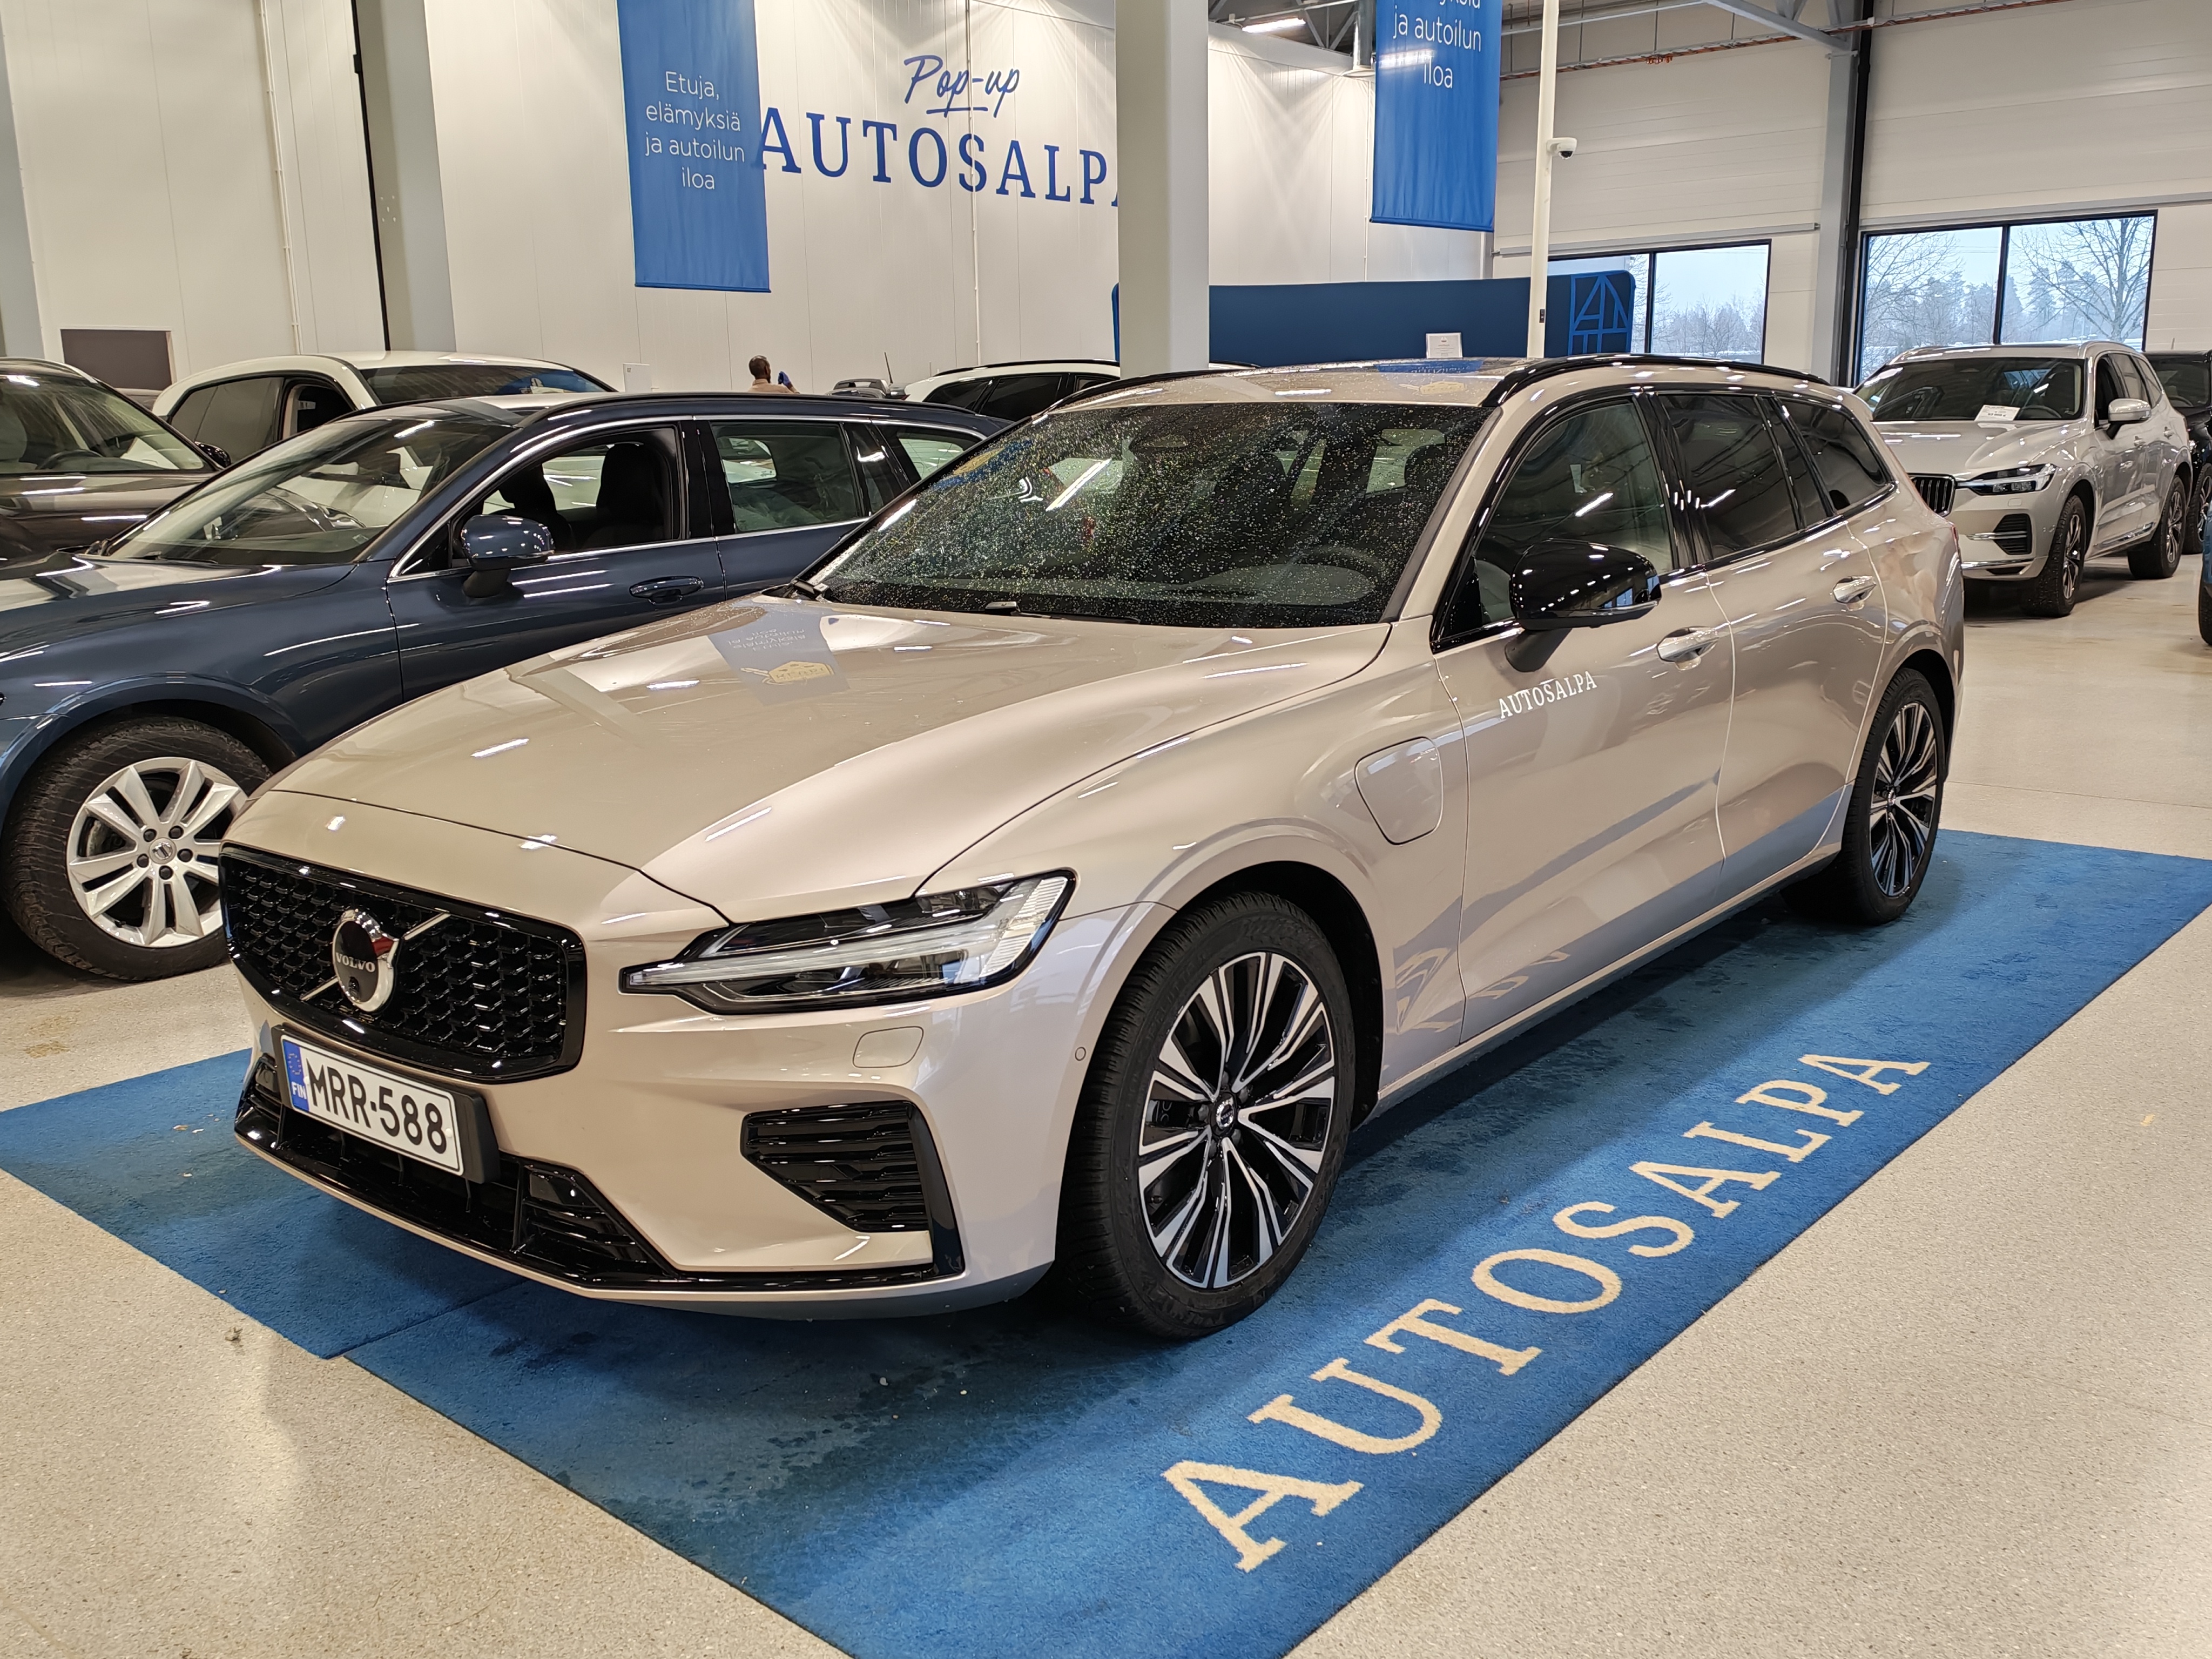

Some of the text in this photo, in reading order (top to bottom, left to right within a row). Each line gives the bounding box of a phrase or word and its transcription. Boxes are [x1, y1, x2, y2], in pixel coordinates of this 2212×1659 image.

[1393, 5, 1481, 52] ja autoilun
[665, 71, 720, 100] Etuja,
[903, 55, 1020, 118] Pop-up
[1424, 57, 1453, 89] iloa
[645, 101, 741, 132] elämyksiä
[645, 132, 745, 163] ja autoilun
[752, 106, 1118, 207] AUTOSALP
[681, 166, 716, 190] iloa
[1498, 670, 1598, 720] AUTOSALPA
[335, 952, 376, 973] VOLVO
[291, 1081, 307, 1100] FIN
[306, 1057, 447, 1155] MRR-588
[1161, 1053, 1932, 1574] AUTOSALPA
